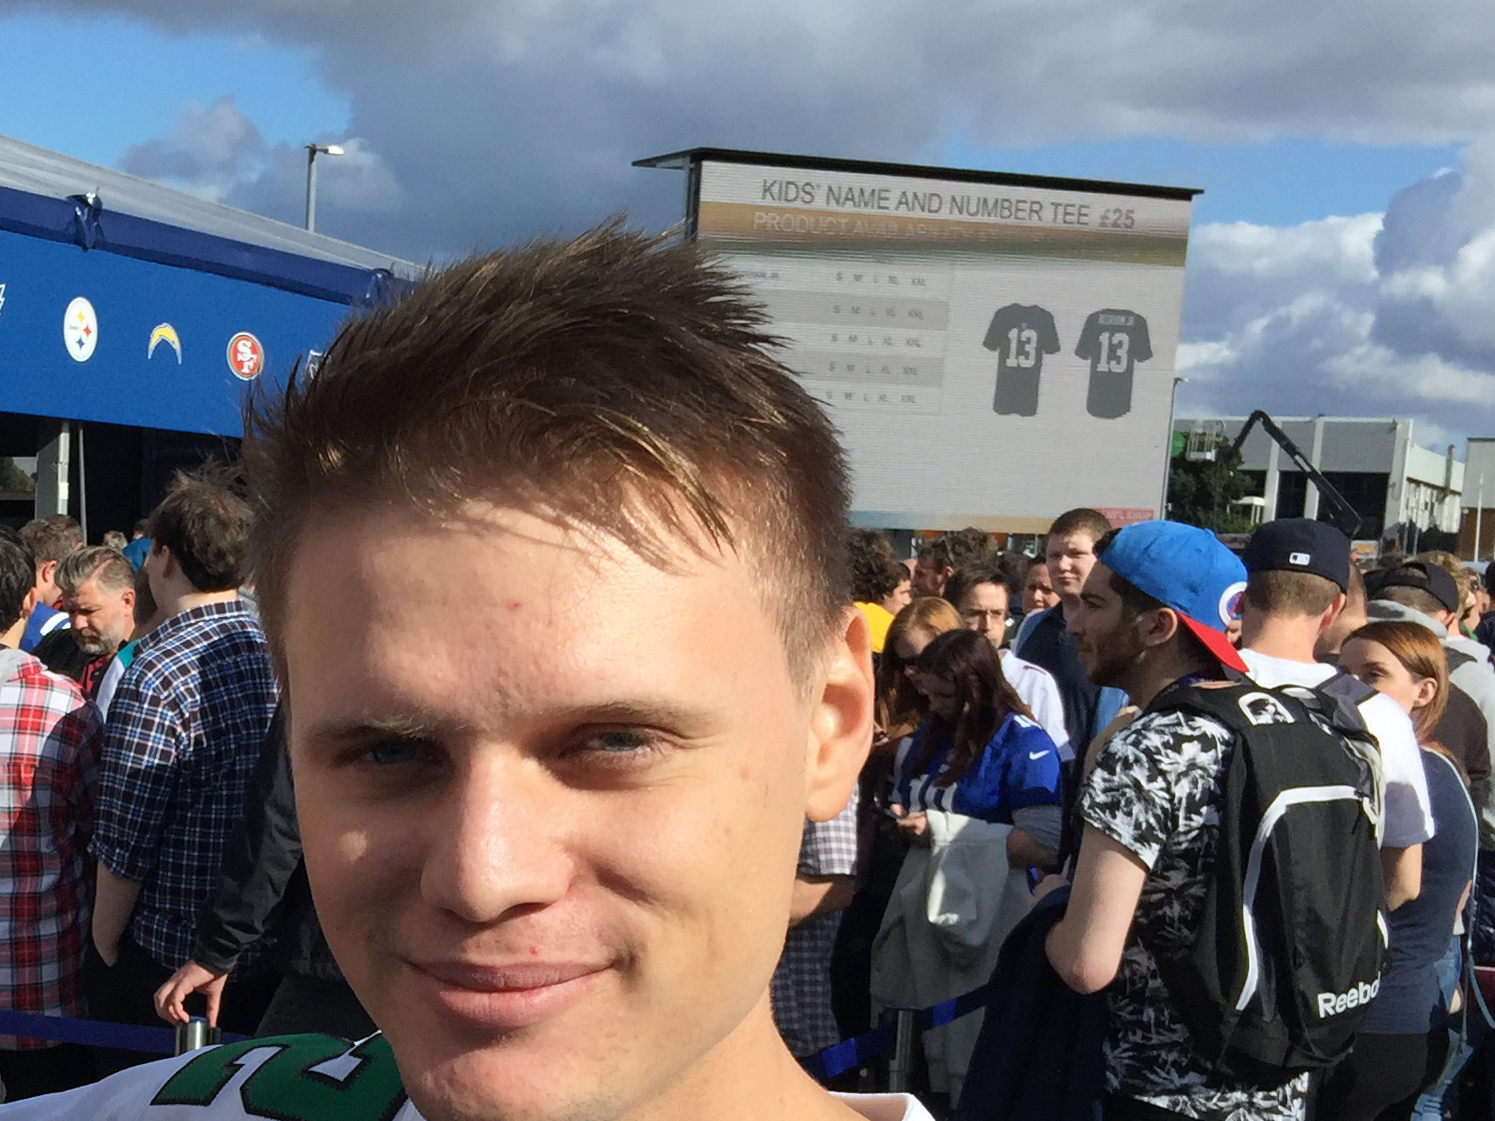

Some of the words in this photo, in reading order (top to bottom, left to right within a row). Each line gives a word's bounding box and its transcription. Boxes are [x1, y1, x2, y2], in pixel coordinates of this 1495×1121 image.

[826, 185, 891, 211] NAME
[895, 189, 943, 214] AND
[949, 194, 1044, 222] NUMBER
[1050, 201, 1090, 226] TEE
[1005, 327, 1038, 369] 13
[1096, 331, 1130, 374] 13
[1317, 970, 1382, 1019] Reebo
